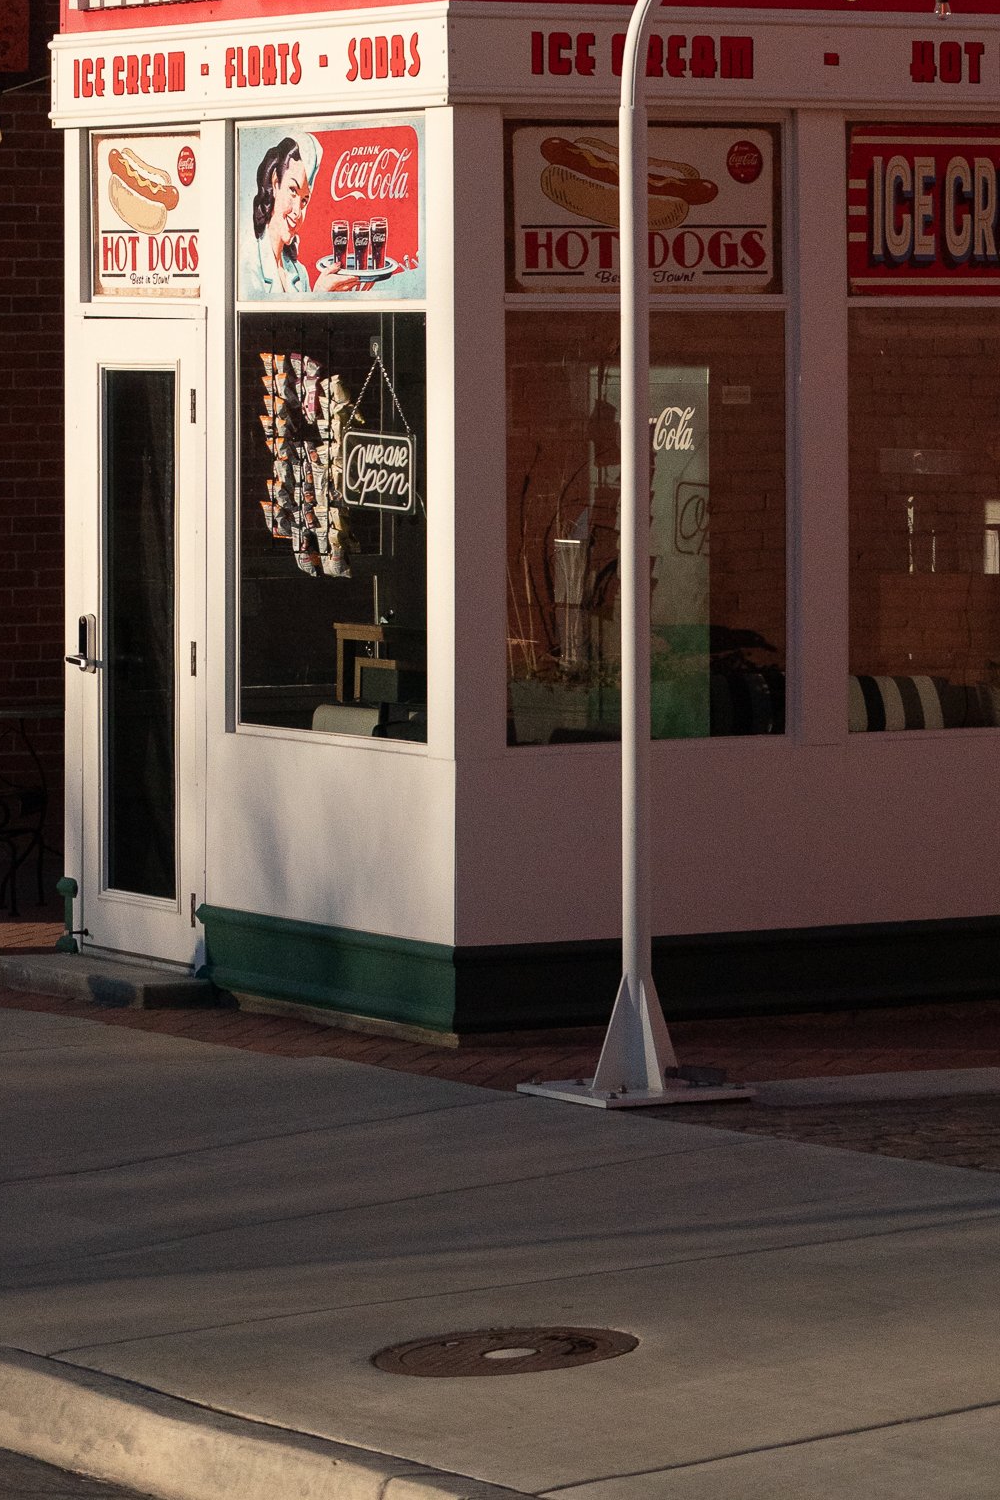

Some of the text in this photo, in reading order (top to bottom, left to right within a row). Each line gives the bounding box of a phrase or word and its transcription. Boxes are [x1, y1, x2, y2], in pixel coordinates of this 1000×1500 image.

[74, 32, 421, 99] ICE CREAM FLOATS SODAS
[531, 31, 596, 77] ICE
[910, 41, 985, 84] HOT
[331, 148, 412, 202] Coca-Cola
[351, 146, 380, 156] DRINK
[872, 155, 936, 261] ICE
[102, 234, 199, 272] HOT DOGS
[524, 230, 767, 270] HOT DOGS
[653, 271, 696, 283] Town!
[346, 443, 410, 506] Open
